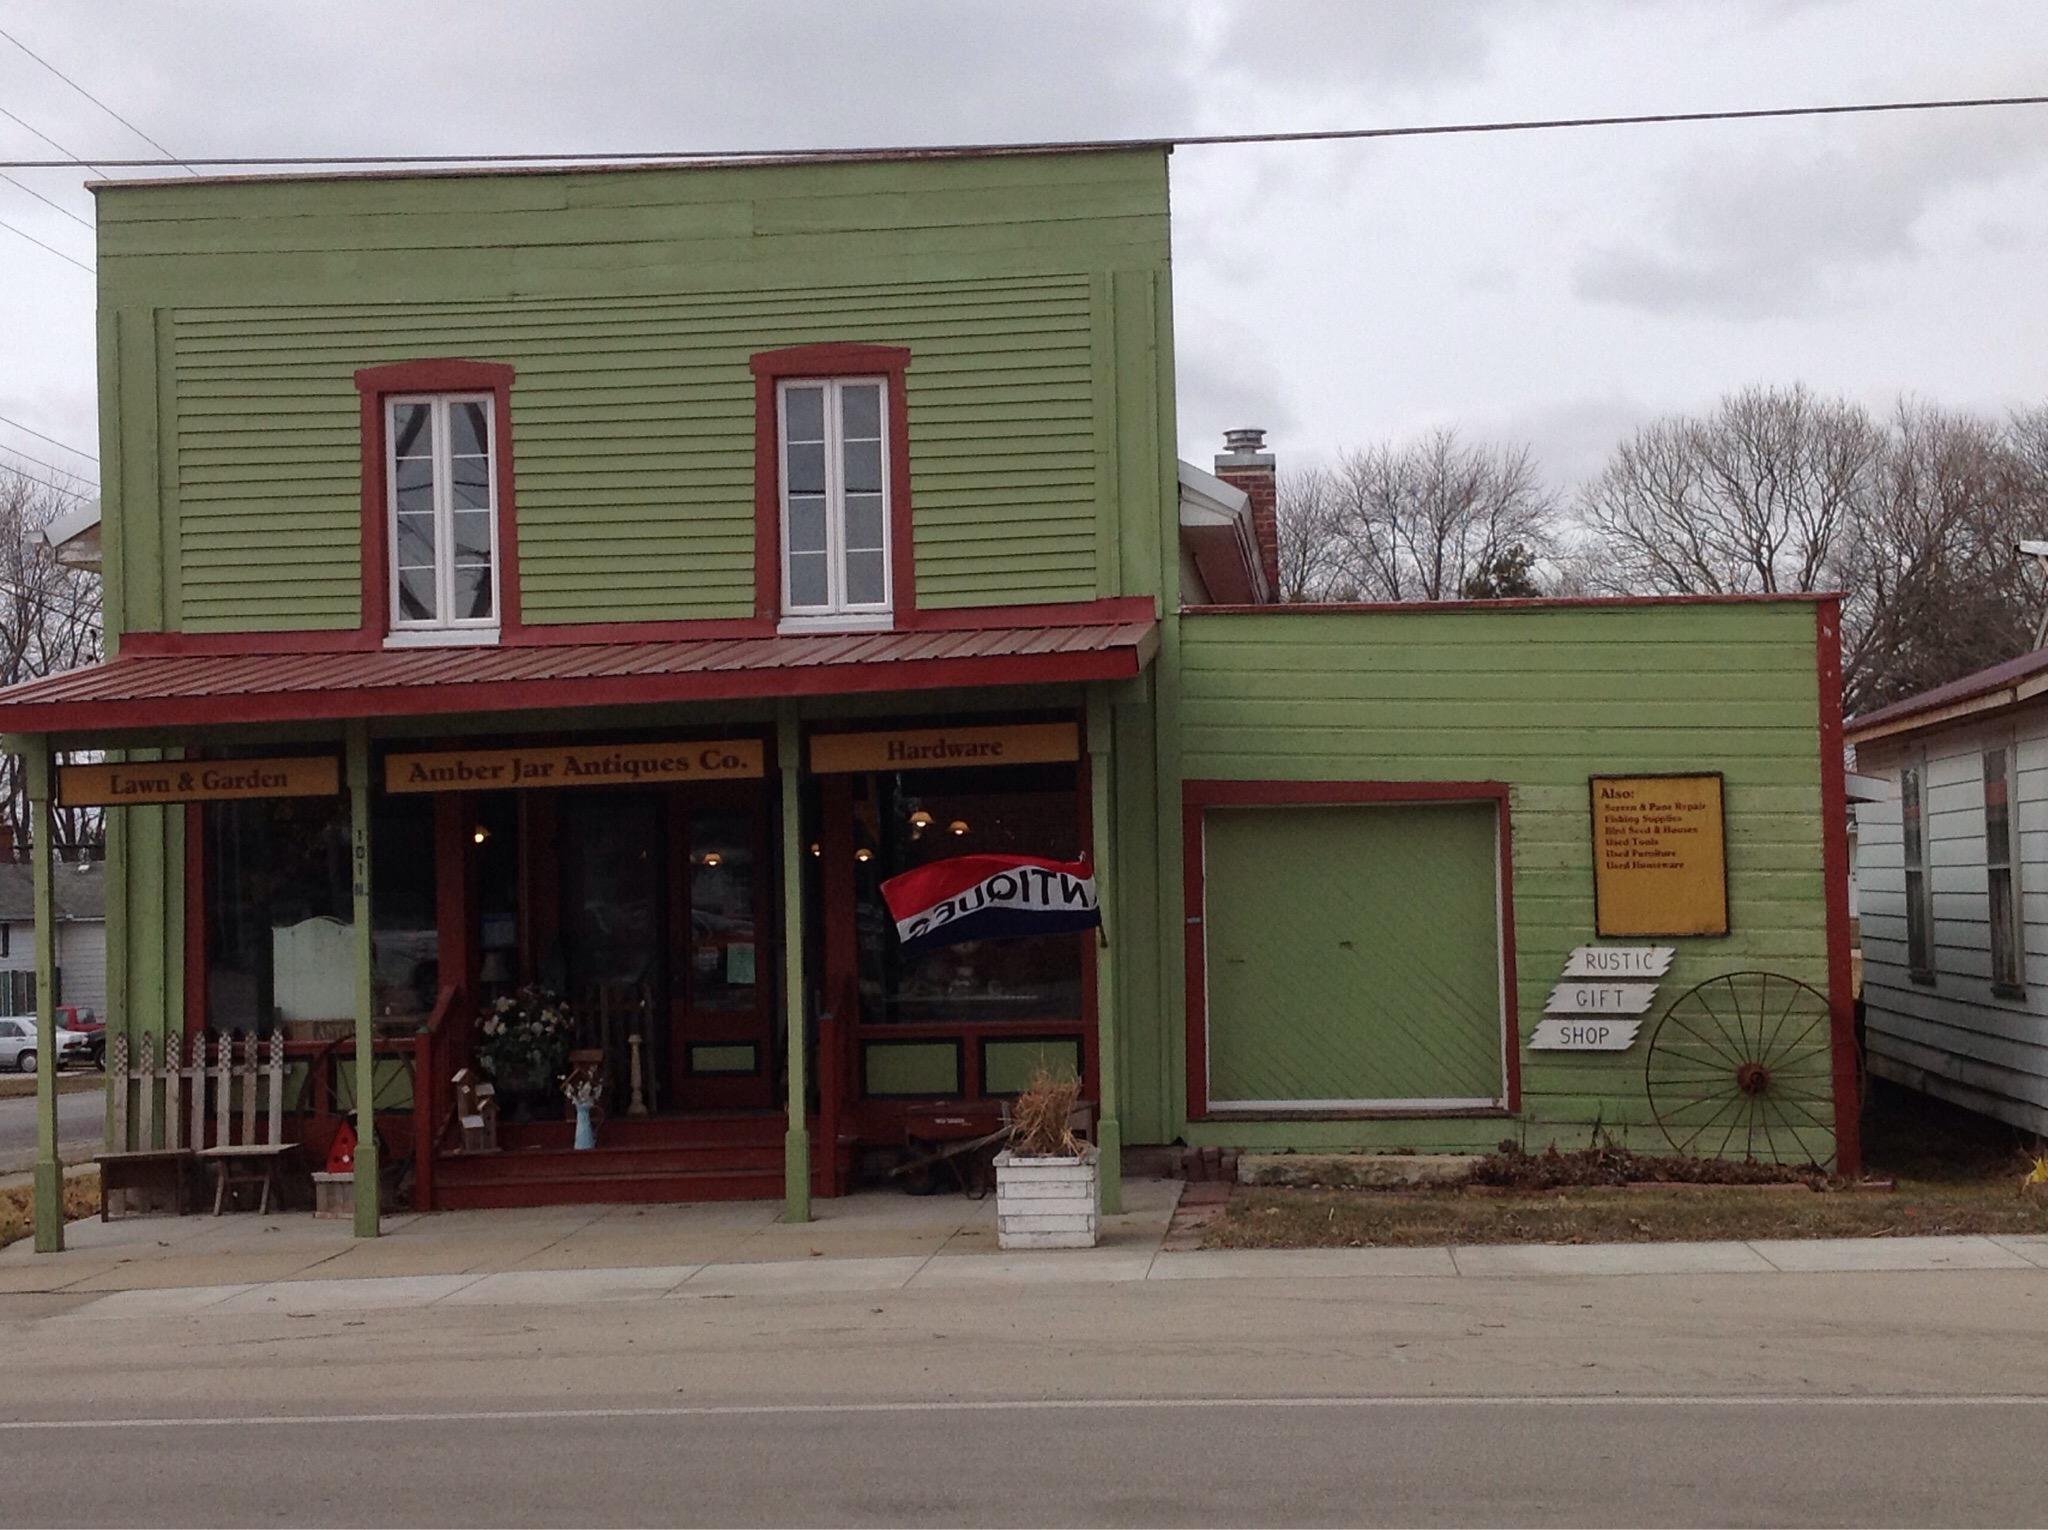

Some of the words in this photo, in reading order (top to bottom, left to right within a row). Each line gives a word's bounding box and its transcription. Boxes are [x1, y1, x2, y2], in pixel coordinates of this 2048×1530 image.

[887, 738, 1004, 761] Hardware
[408, 760, 505, 783] Amber
[511, 757, 554, 783] Jar
[562, 753, 690, 777] Antiques
[700, 749, 748, 770] Co.
[110, 773, 171, 795] Lawn
[176, 771, 196, 791] &
[201, 768, 289, 790] Garden
[1600, 788, 1634, 799] Also:
[1605, 804, 1637, 812] Screen
[1640, 803, 1647, 811] &
[1674, 801, 1706, 812] Repair
[1605, 815, 1640, 824] Fishing
[1643, 814, 1682, 823] Supplies
[1605, 826, 1626, 835] Bird
[1628, 826, 1651, 834] Seed
[1663, 825, 1698, 834] Houses
[1606, 838, 1629, 847] Used
[1632, 837, 1659, 846] Tools
[1606, 849, 1630, 858] Used
[1632, 849, 1676, 858] Furniture
[1606, 861, 1630, 870] Used
[1586, 953, 1653, 970] RUSTIC
[1576, 989, 1624, 1007] GIFT
[1560, 1027, 1610, 1045] SHOP
